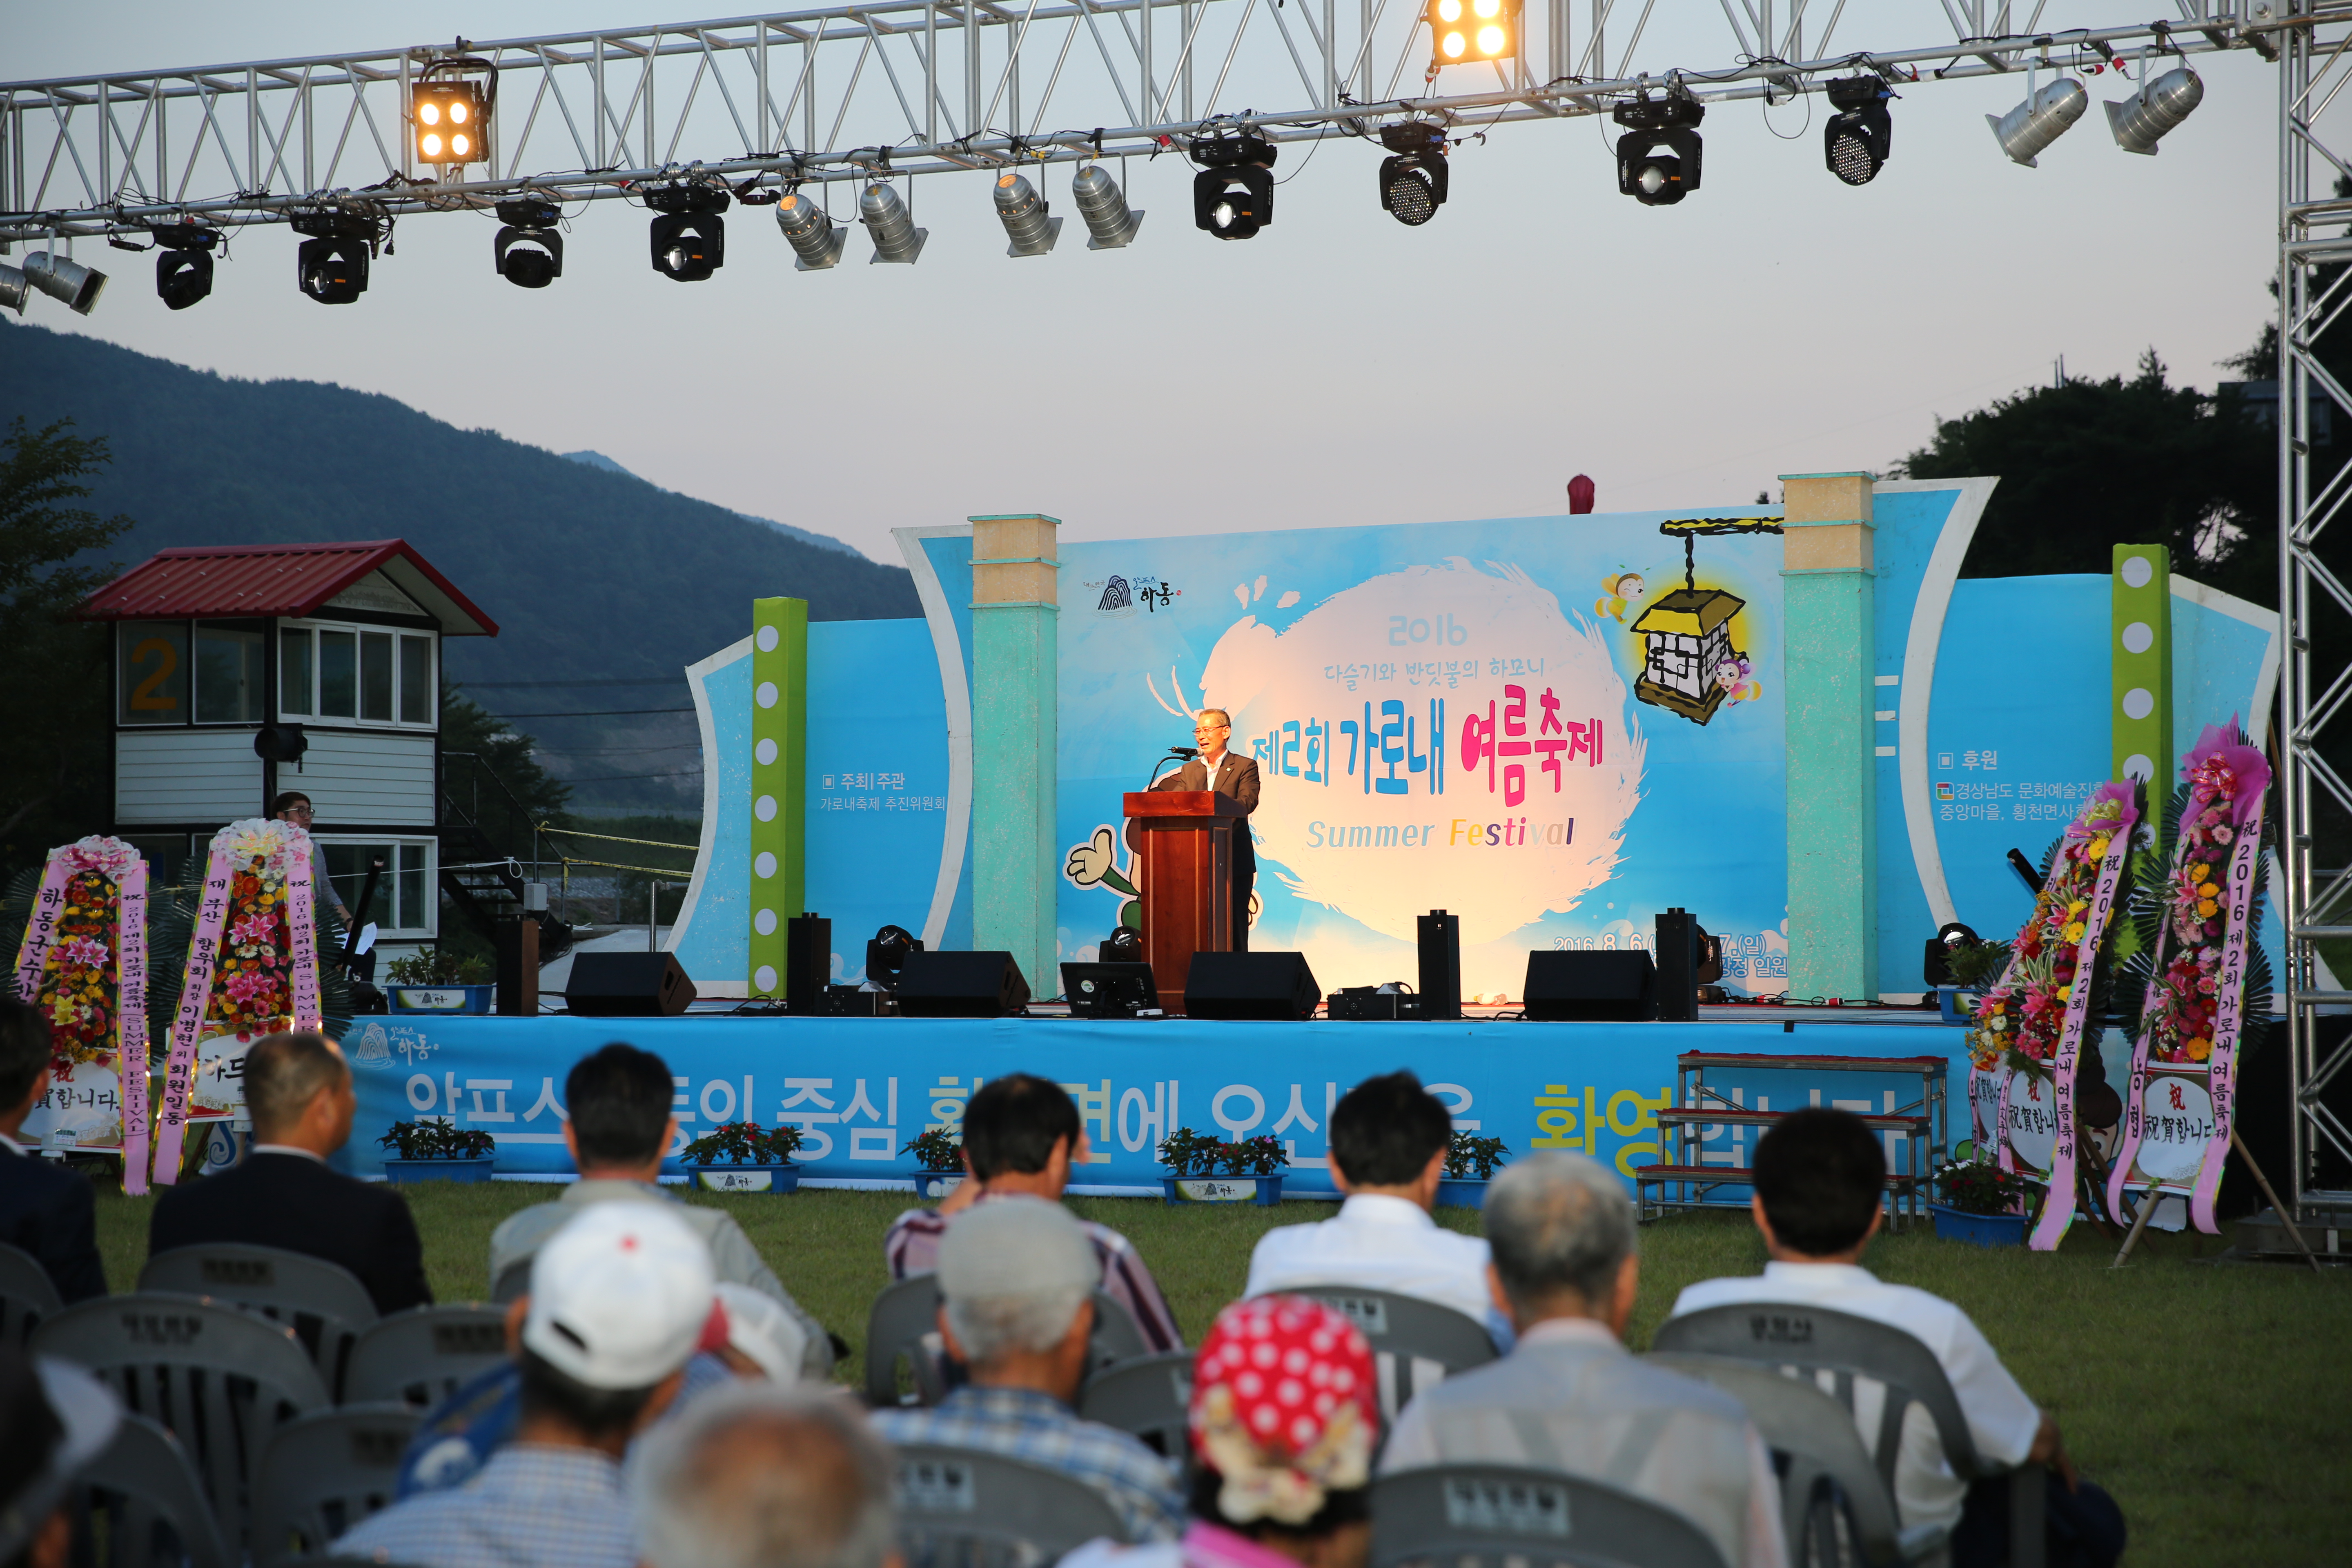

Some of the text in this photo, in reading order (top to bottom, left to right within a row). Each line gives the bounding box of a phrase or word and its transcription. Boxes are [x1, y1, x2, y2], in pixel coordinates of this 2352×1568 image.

[1140, 582, 1174, 612] 하동
[1389, 613, 1468, 646] 2016
[131, 638, 177, 710] 2
[1324, 657, 1544, 691] 다슬기와 반딧불의 하모니
[1252, 684, 1603, 808] 제2회 가로내 여름축제
[1962, 750, 1997, 770] 후원
[821, 797, 945, 811] 가로내축제 추진위원회
[1956, 783, 2013, 800] 경상남도
[1940, 804, 2005, 821] 중앙마을,
[1307, 817, 1575, 849] Summer Festival
[2103, 855, 2120, 871] 祝
[128, 906, 138, 929] 2016
[296, 894, 307, 920] 2016
[2089, 878, 2113, 951] 2016
[1755, 957, 1788, 978] 일원
[2212, 820, 2257, 1143] 祝 2016 제2회 가로내 여름축제
[296, 973, 318, 1032] SUMMER
[398, 1033, 431, 1066] 하동
[2059, 1020, 2080, 1076] 가로내
[2169, 1082, 2186, 1111] 祝
[777, 1077, 898, 1160] 중심
[2057, 1082, 2073, 1160] 여름축제
